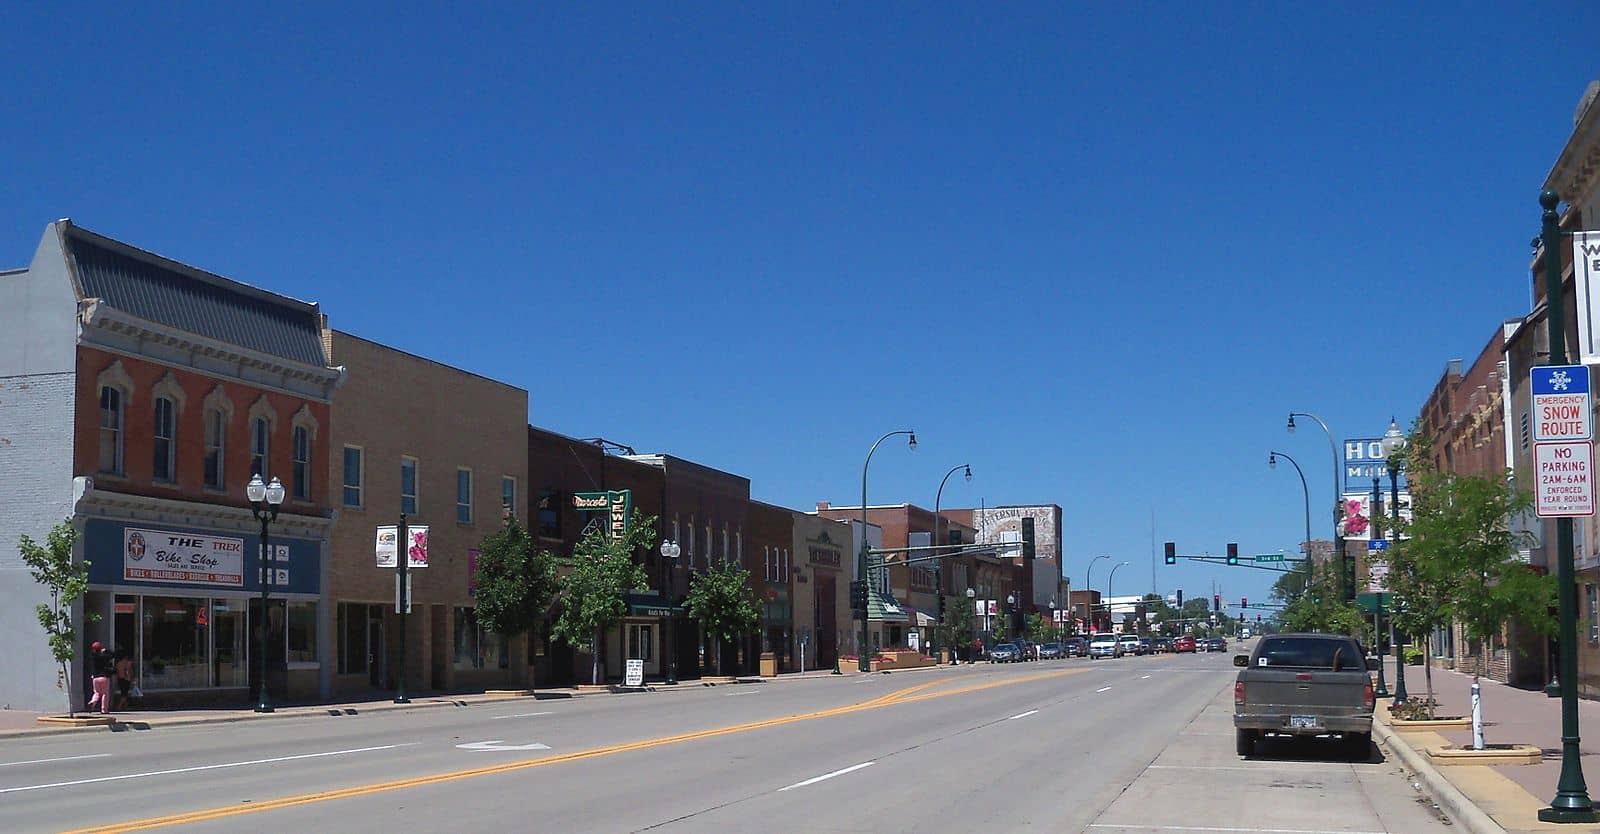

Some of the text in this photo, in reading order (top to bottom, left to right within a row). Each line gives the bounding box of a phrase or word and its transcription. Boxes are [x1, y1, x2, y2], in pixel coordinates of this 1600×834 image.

[1536, 396, 1585, 405] EMERGENCY
[1543, 406, 1580, 420] SNOW
[1541, 421, 1584, 436] ROUTE
[1554, 447, 1572, 459] NO
[1542, 461, 1585, 472] PARKING
[1542, 474, 1586, 484] 2AM-6AM
[1547, 486, 1583, 494] ENFORCED
[1564, 495, 1588, 503] ROUND
[168, 537, 204, 548] THE
[212, 541, 241, 552] TREK
[155, 549, 219, 569] Bike Shop
